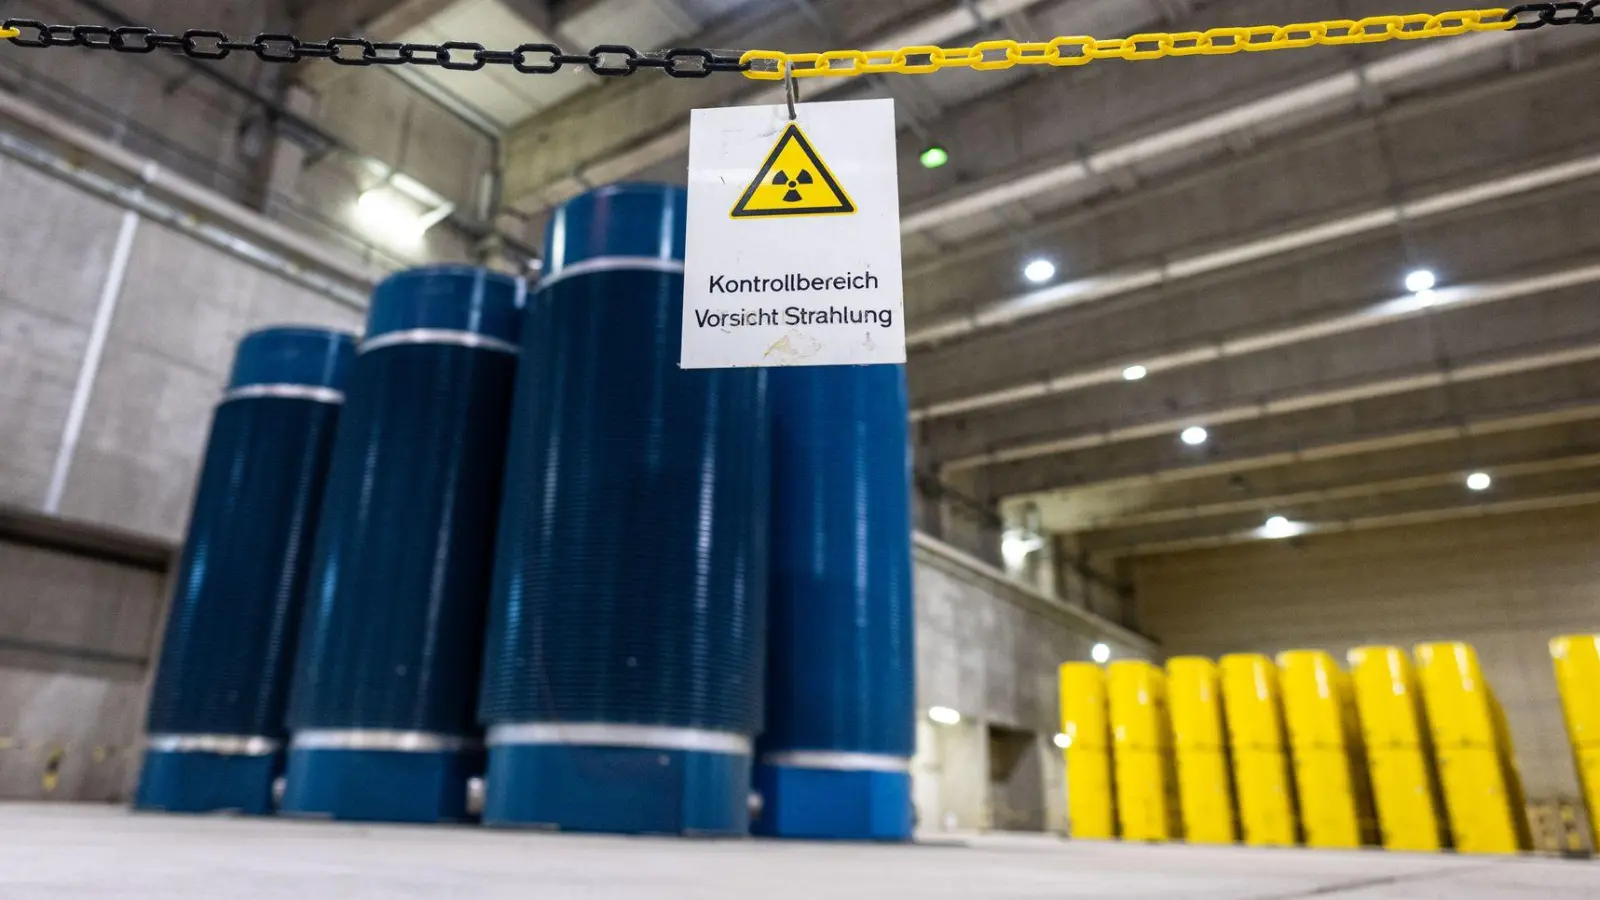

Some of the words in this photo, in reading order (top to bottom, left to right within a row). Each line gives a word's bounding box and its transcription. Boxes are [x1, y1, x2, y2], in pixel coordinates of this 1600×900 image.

[709, 271, 878, 294] Kontrollbereich
[694, 307, 779, 328] Vorsicht
[785, 305, 892, 328] Strahlung
